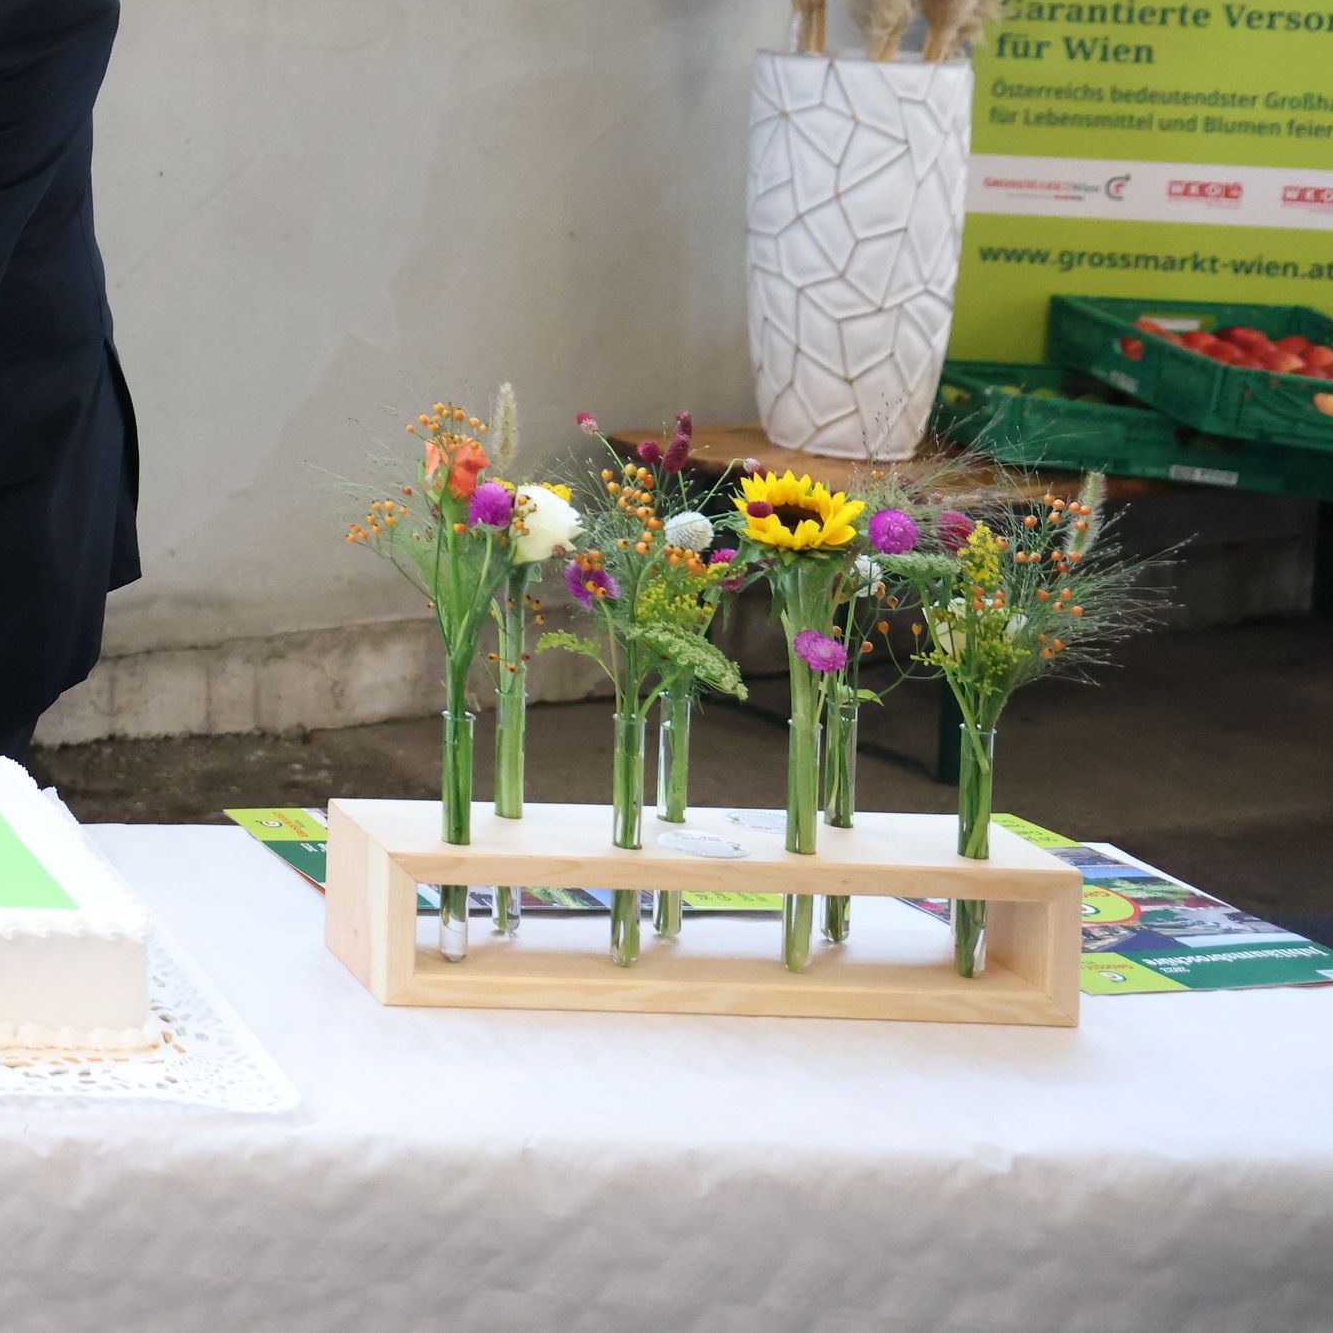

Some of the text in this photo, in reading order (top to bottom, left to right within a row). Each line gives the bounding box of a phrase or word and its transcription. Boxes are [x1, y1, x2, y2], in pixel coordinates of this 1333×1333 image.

[996, 32, 1155, 64] für Wien
[989, 106, 1018, 125] für
[1158, 115, 1198, 133] und
[1204, 116, 1281, 136] Blumen
